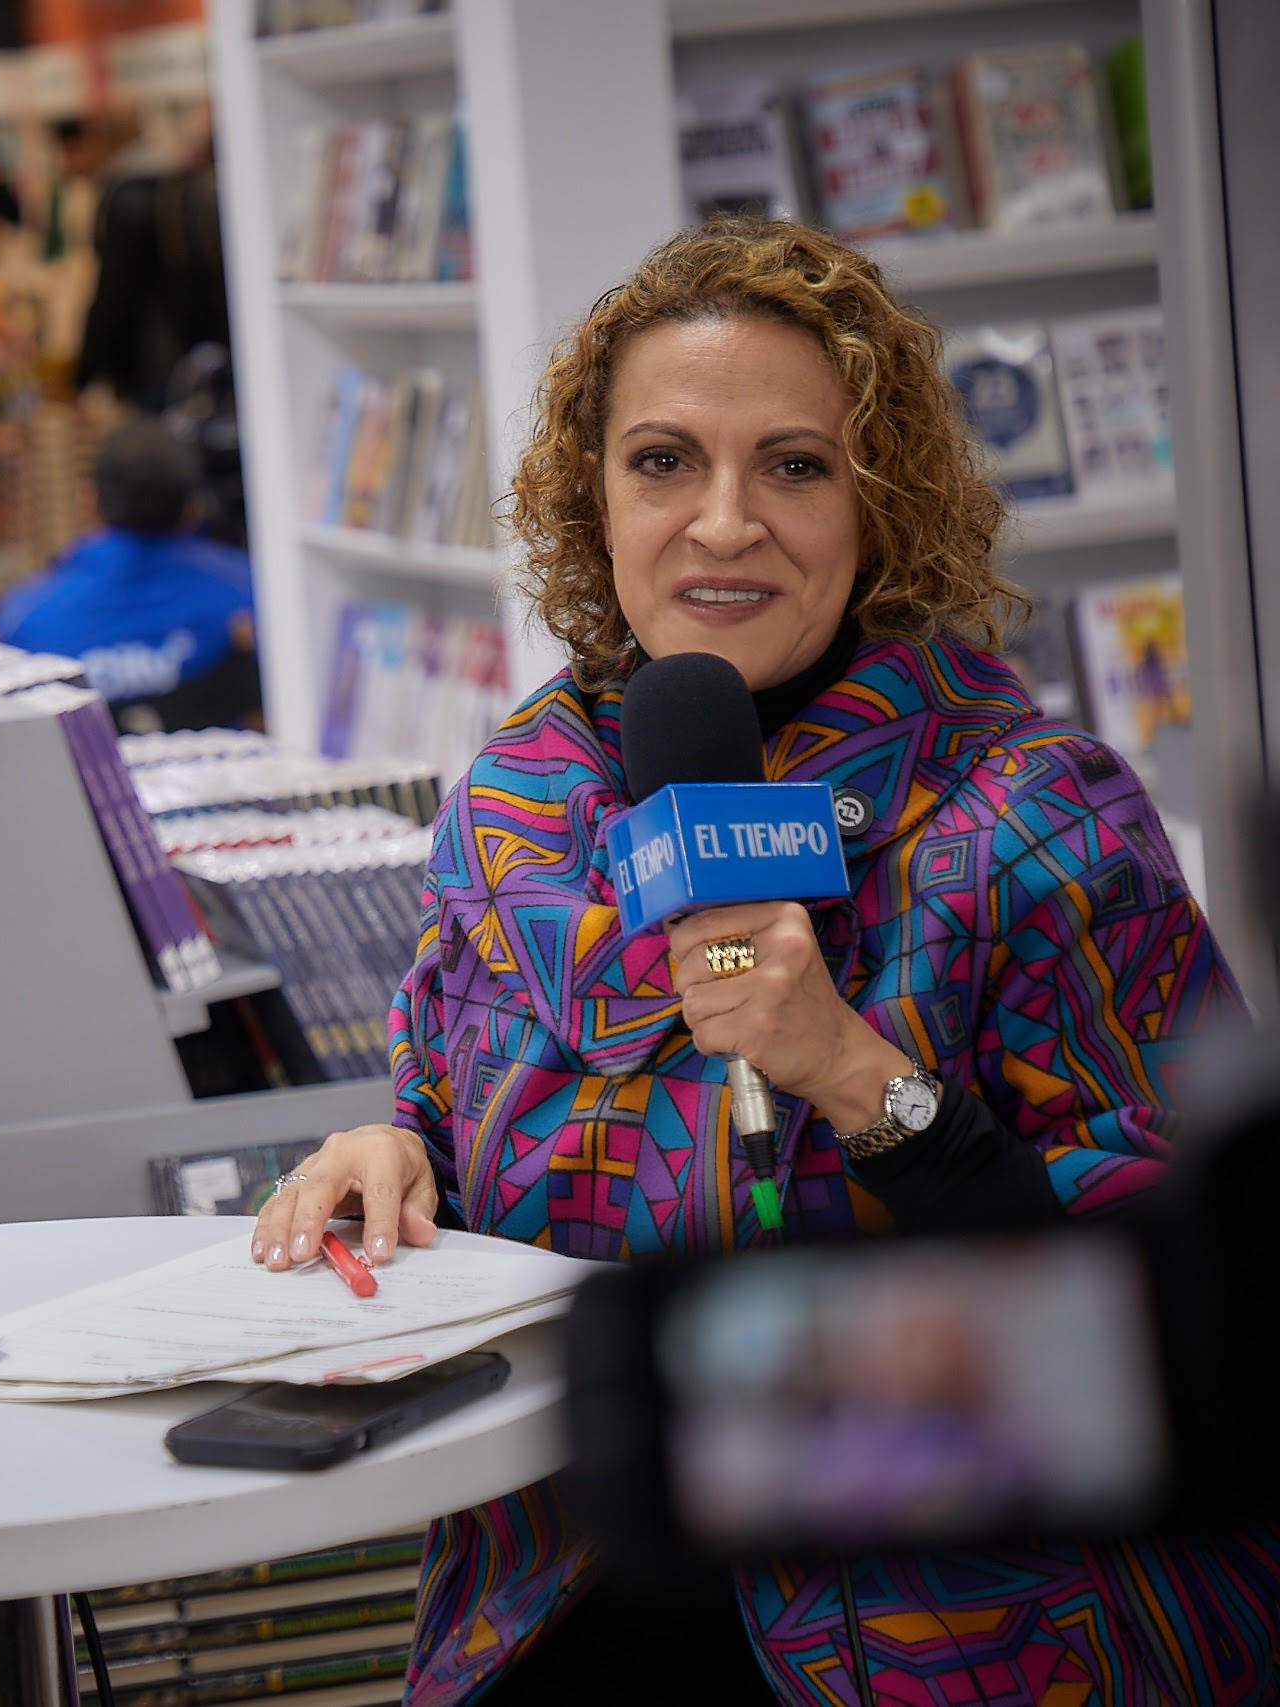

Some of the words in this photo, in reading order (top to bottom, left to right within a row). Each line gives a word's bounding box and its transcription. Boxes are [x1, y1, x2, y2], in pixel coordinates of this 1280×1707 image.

[618, 859, 634, 896] EL
[631, 832, 674, 885] TIEMPO
[694, 825, 727, 858] EL
[729, 822, 828, 857] TIEMPO
